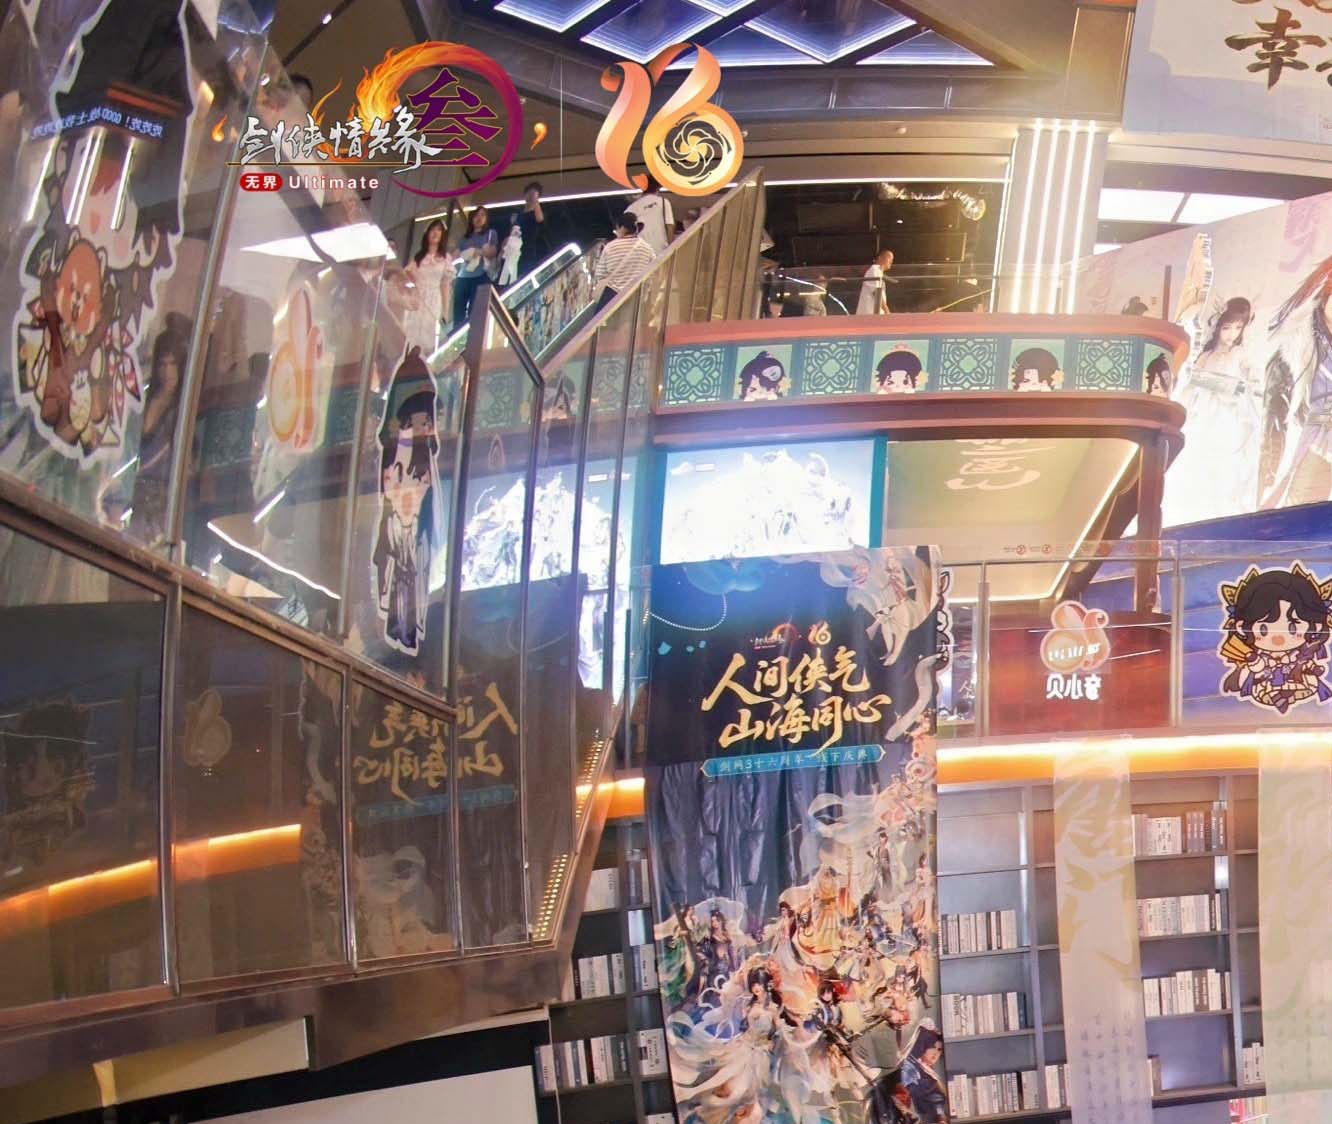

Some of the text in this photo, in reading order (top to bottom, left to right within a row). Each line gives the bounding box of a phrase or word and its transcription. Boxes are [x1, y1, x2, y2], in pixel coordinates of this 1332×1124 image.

[701, 646, 872, 712] 人间侠气
[718, 695, 892, 758] 山海同心
